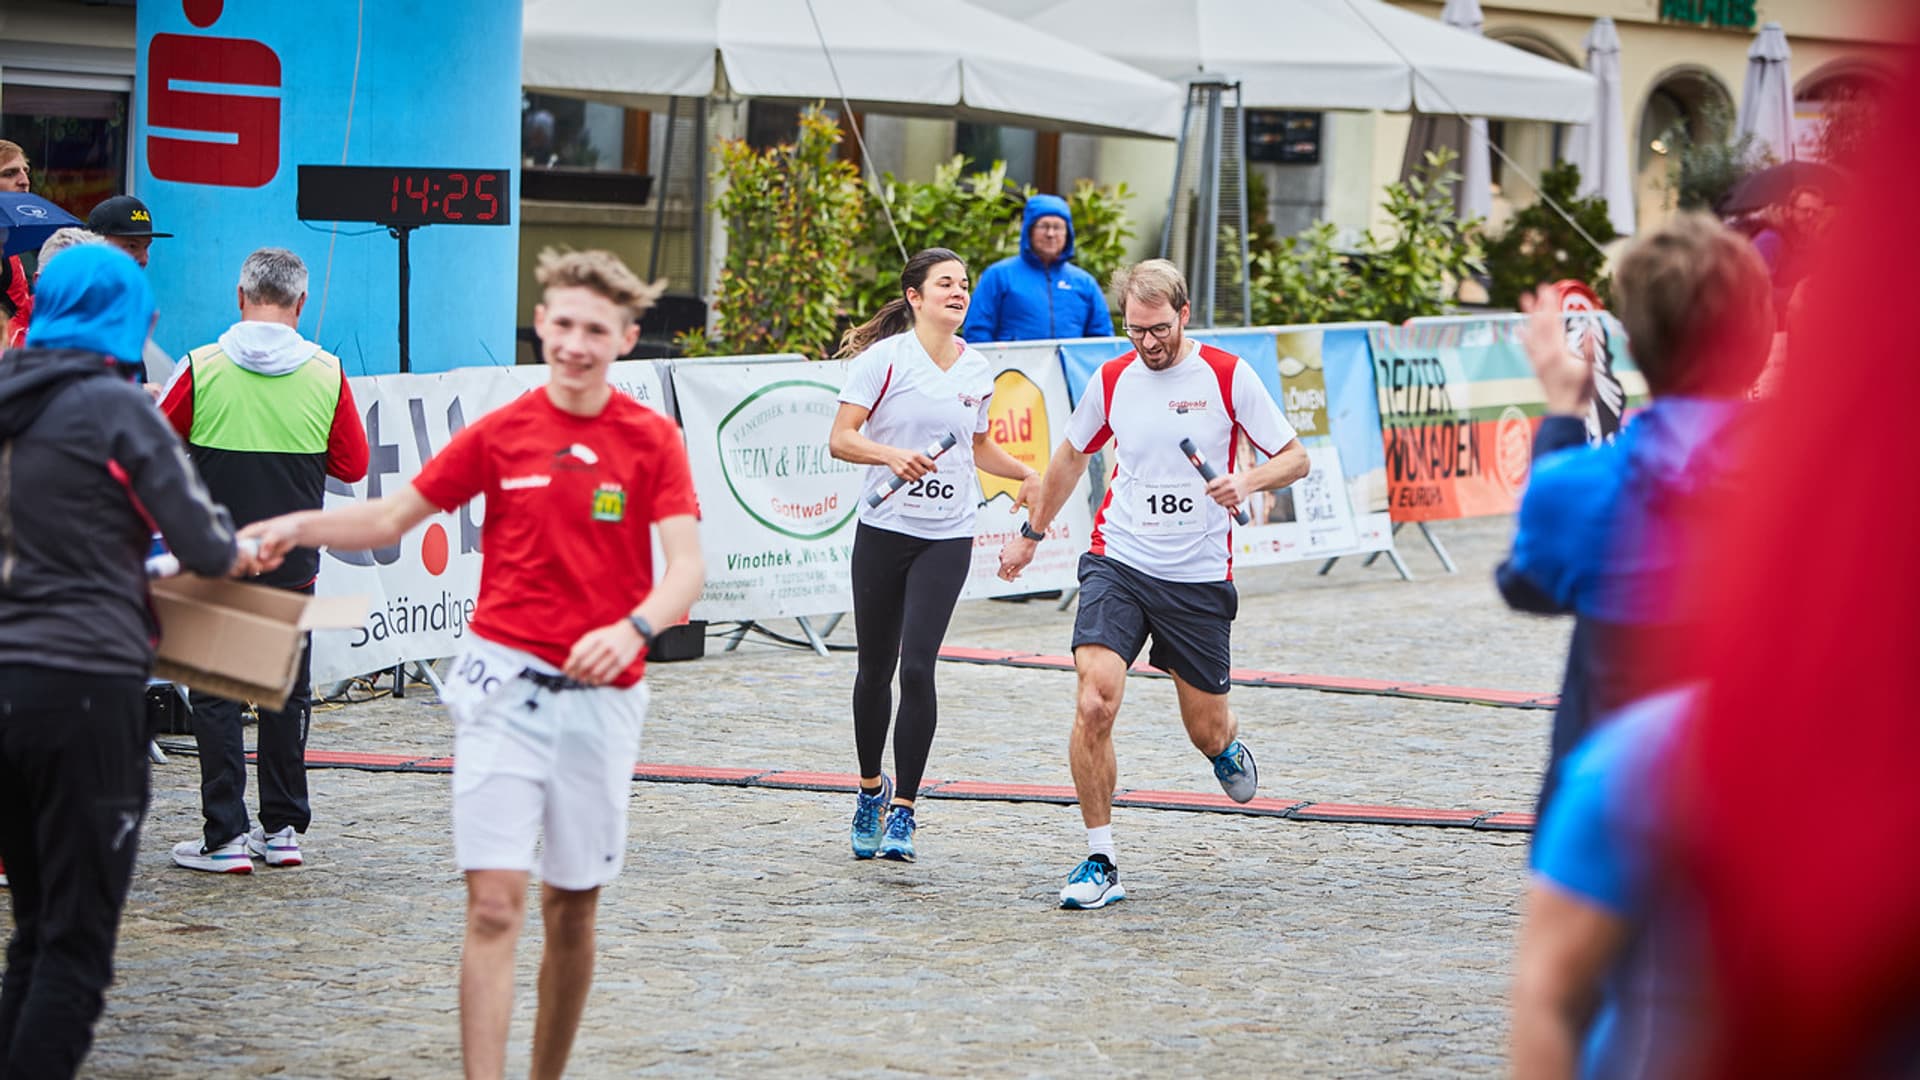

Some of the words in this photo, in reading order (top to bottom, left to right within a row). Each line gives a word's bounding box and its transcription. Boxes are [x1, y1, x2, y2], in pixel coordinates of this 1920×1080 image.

[392, 174, 498, 221] 14:25
[988, 408, 1033, 445] ald
[775, 446, 790, 478] &
[907, 478, 955, 500] 26c
[771, 493, 838, 519] Gottwald
[1146, 494, 1194, 515] 18c
[727, 549, 792, 571] Vinothek
